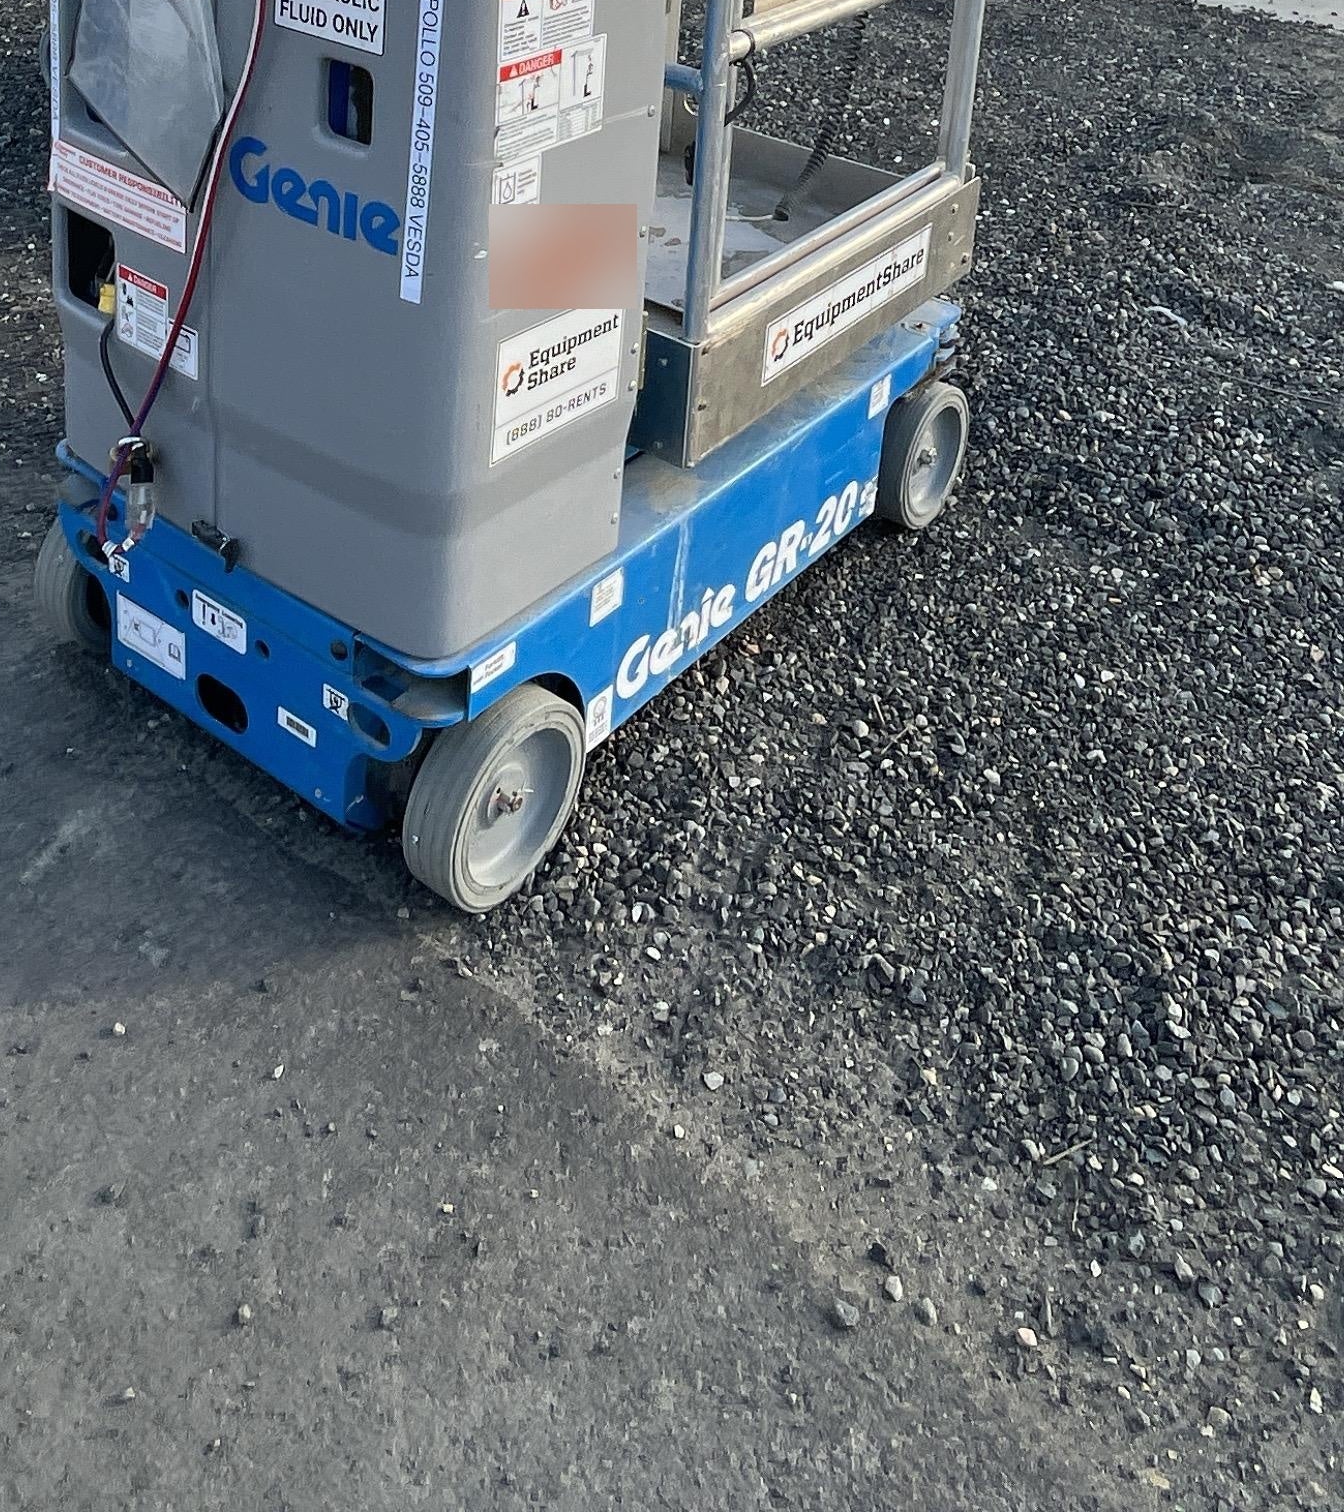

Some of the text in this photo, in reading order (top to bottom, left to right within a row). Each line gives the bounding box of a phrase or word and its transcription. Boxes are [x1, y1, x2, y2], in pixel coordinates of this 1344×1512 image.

[332, 13, 379, 43] ONLY
[518, 53, 555, 75] DANGER
[410, 71, 434, 209] 509-405-5888
[228, 136, 401, 256] Genie
[404, 214, 424, 278] VESDA
[792, 247, 925, 347] EquipmentShare
[528, 314, 619, 370] Equipment
[527, 356, 577, 391] Share
[506, 414, 543, 446] (888)
[616, 583, 737, 700] Genie
